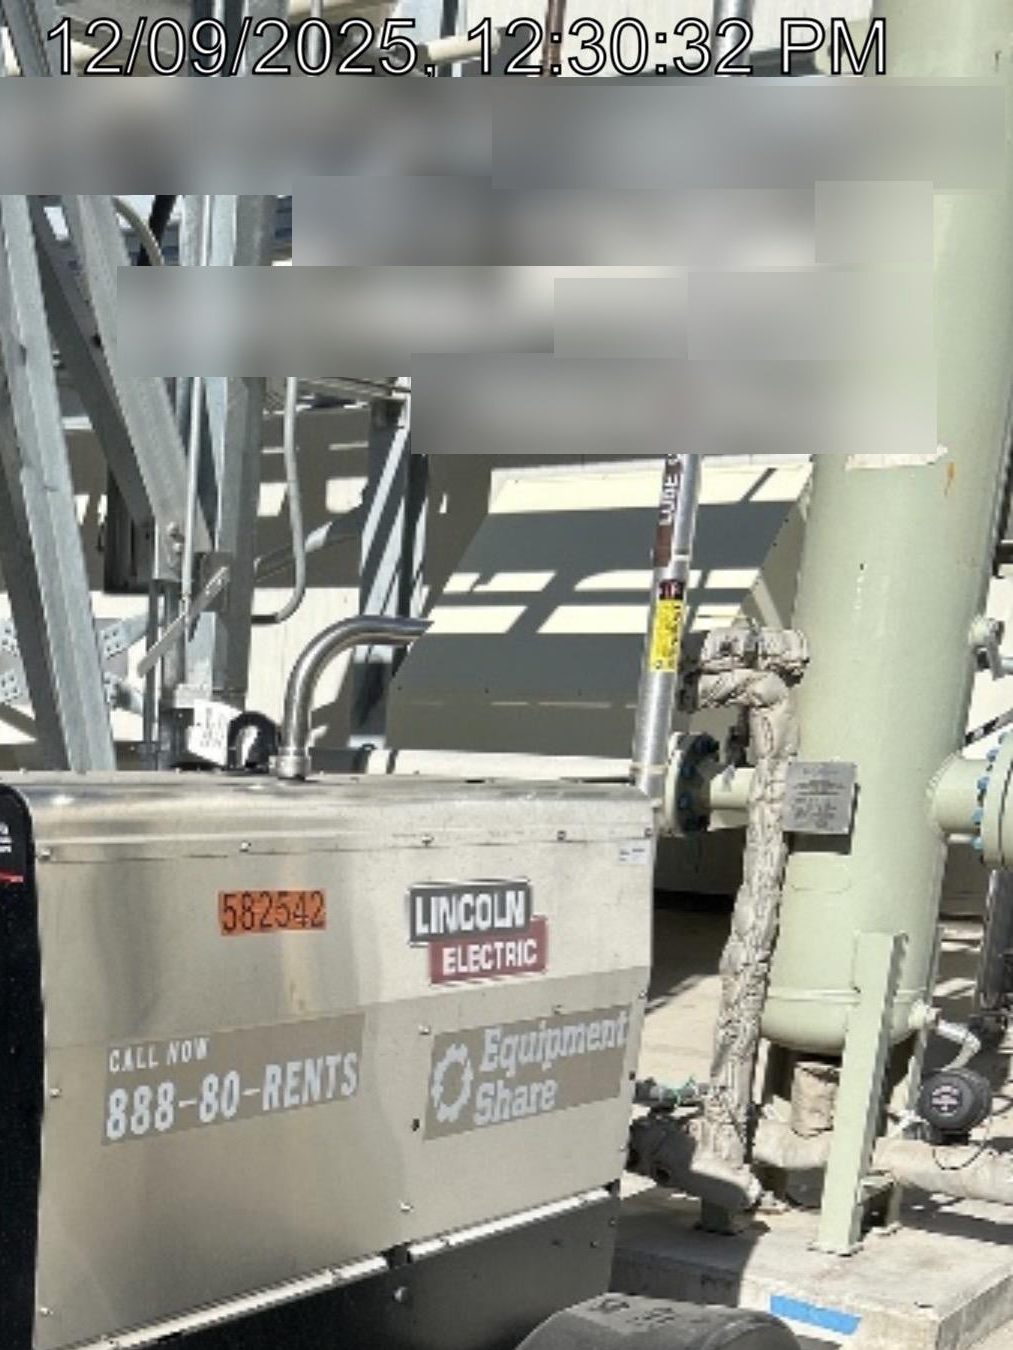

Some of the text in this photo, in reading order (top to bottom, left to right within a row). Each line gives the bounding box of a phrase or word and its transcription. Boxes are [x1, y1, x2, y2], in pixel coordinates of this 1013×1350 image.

[222, 890, 326, 932] 582542
[415, 889, 526, 936] LINCOLN
[442, 938, 538, 976] ELECTRIC
[109, 1038, 210, 1073] CALL NOW
[480, 1010, 630, 1078] Equipment
[106, 1052, 359, 1140] 888-80-RENTS
[475, 1079, 559, 1126] Share
